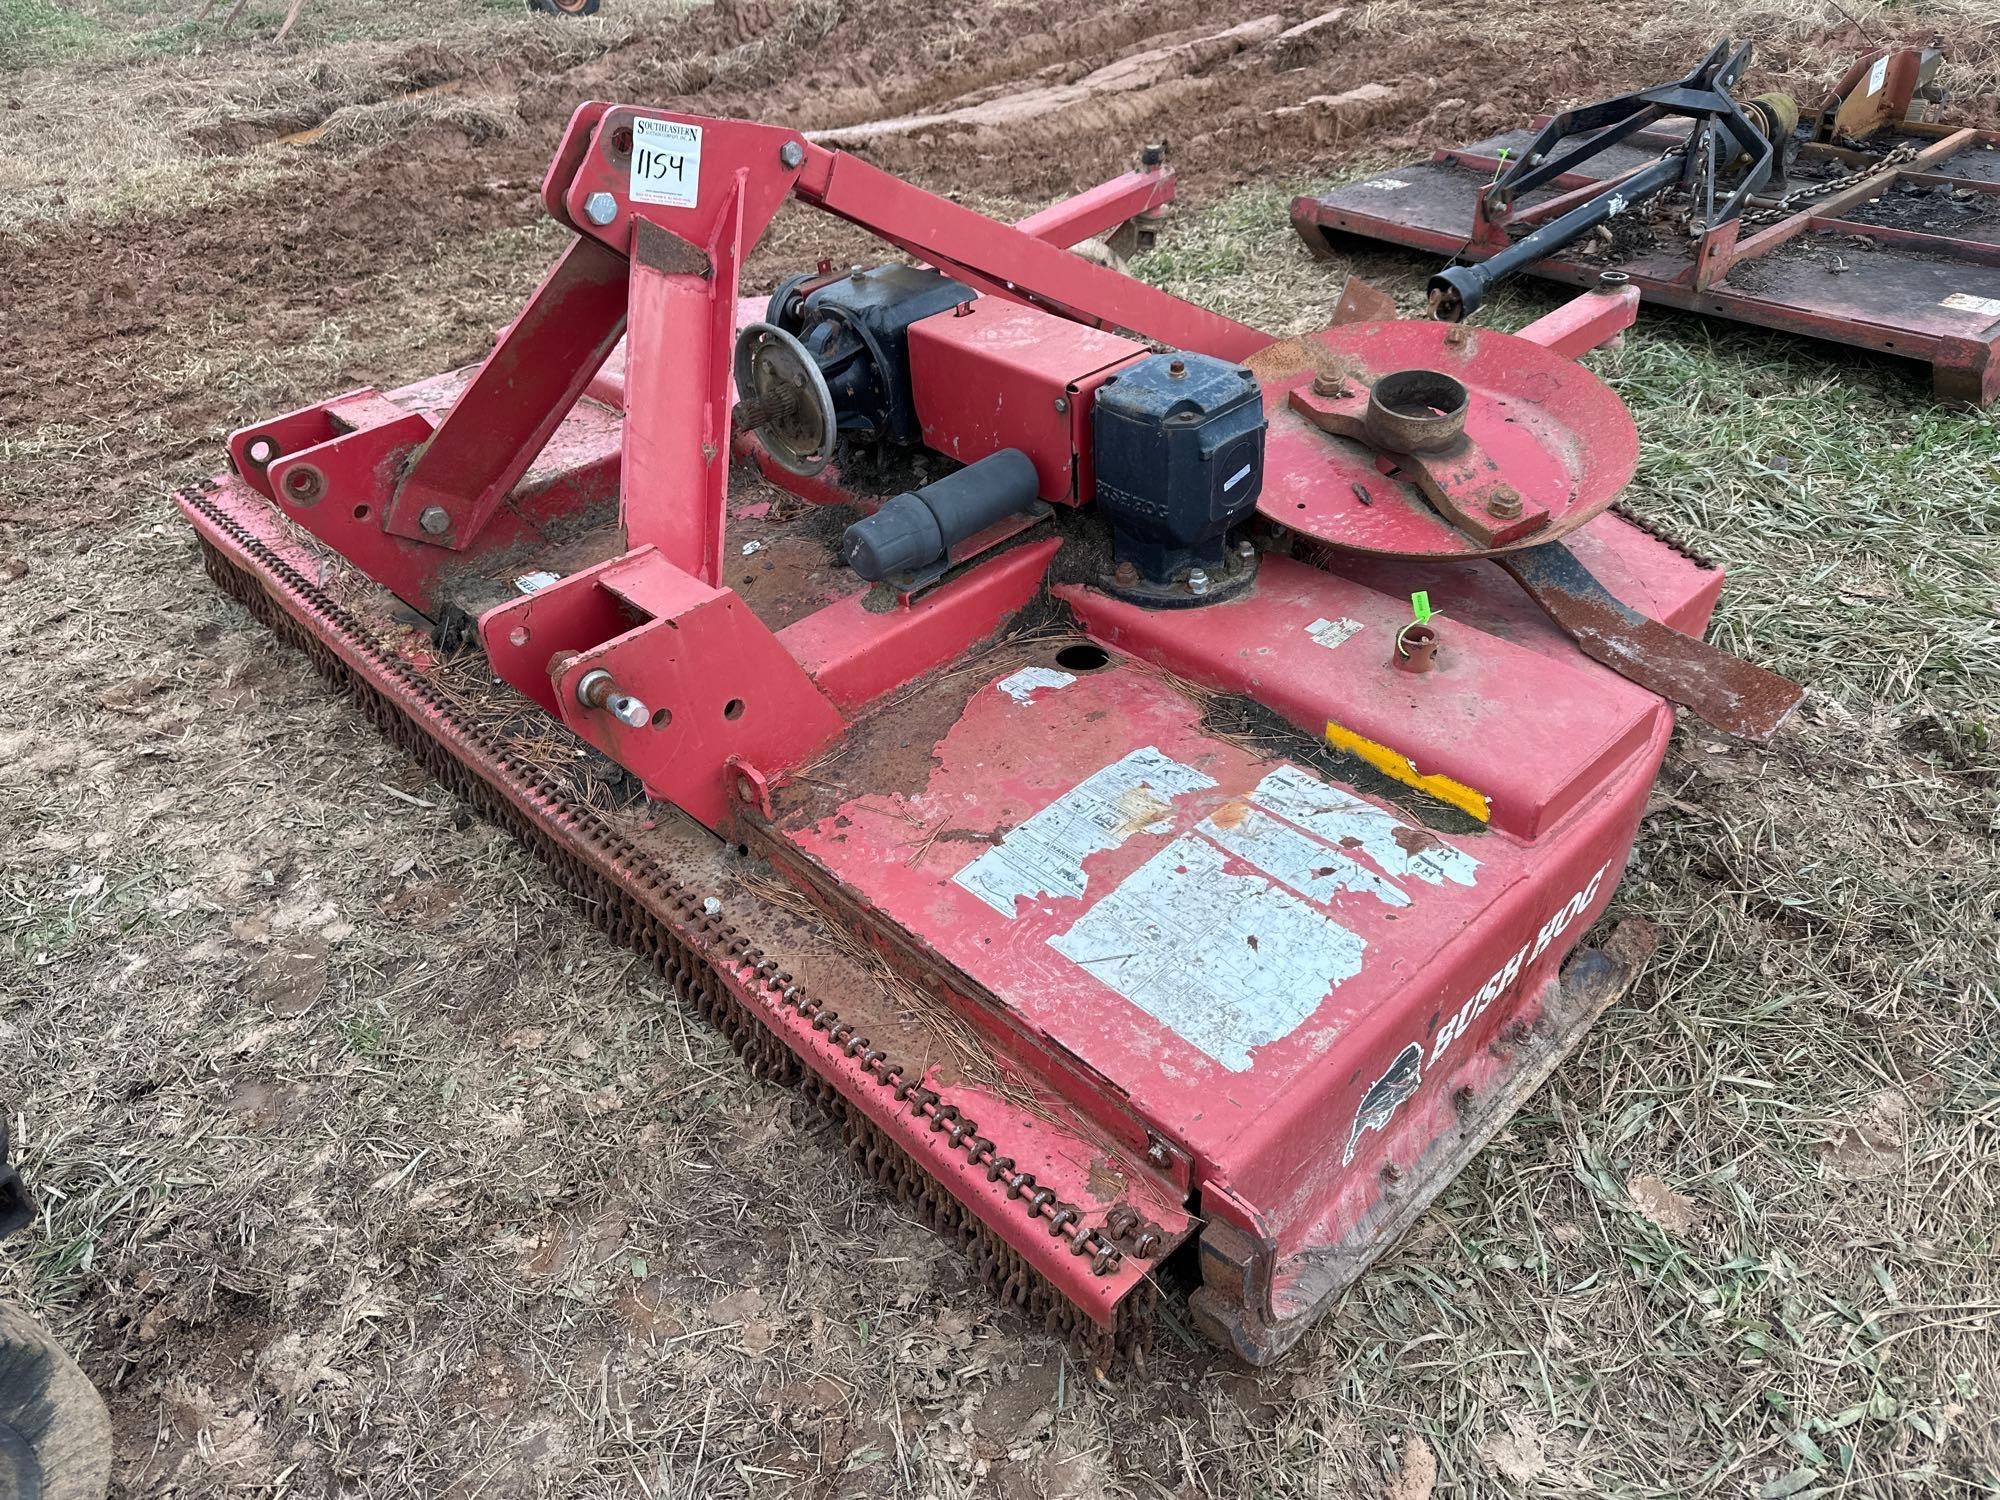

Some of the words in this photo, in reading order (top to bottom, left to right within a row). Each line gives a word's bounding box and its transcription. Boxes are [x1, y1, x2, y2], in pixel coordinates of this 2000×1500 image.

[637, 120, 698, 142] SOUTHEASTERN
[637, 148, 684, 183] 1154
[1106, 803, 1138, 822] WARNING
[1050, 843, 1082, 866] WARNING
[1425, 940, 1532, 1072] BUSH
[1526, 861, 1608, 968] HOG
